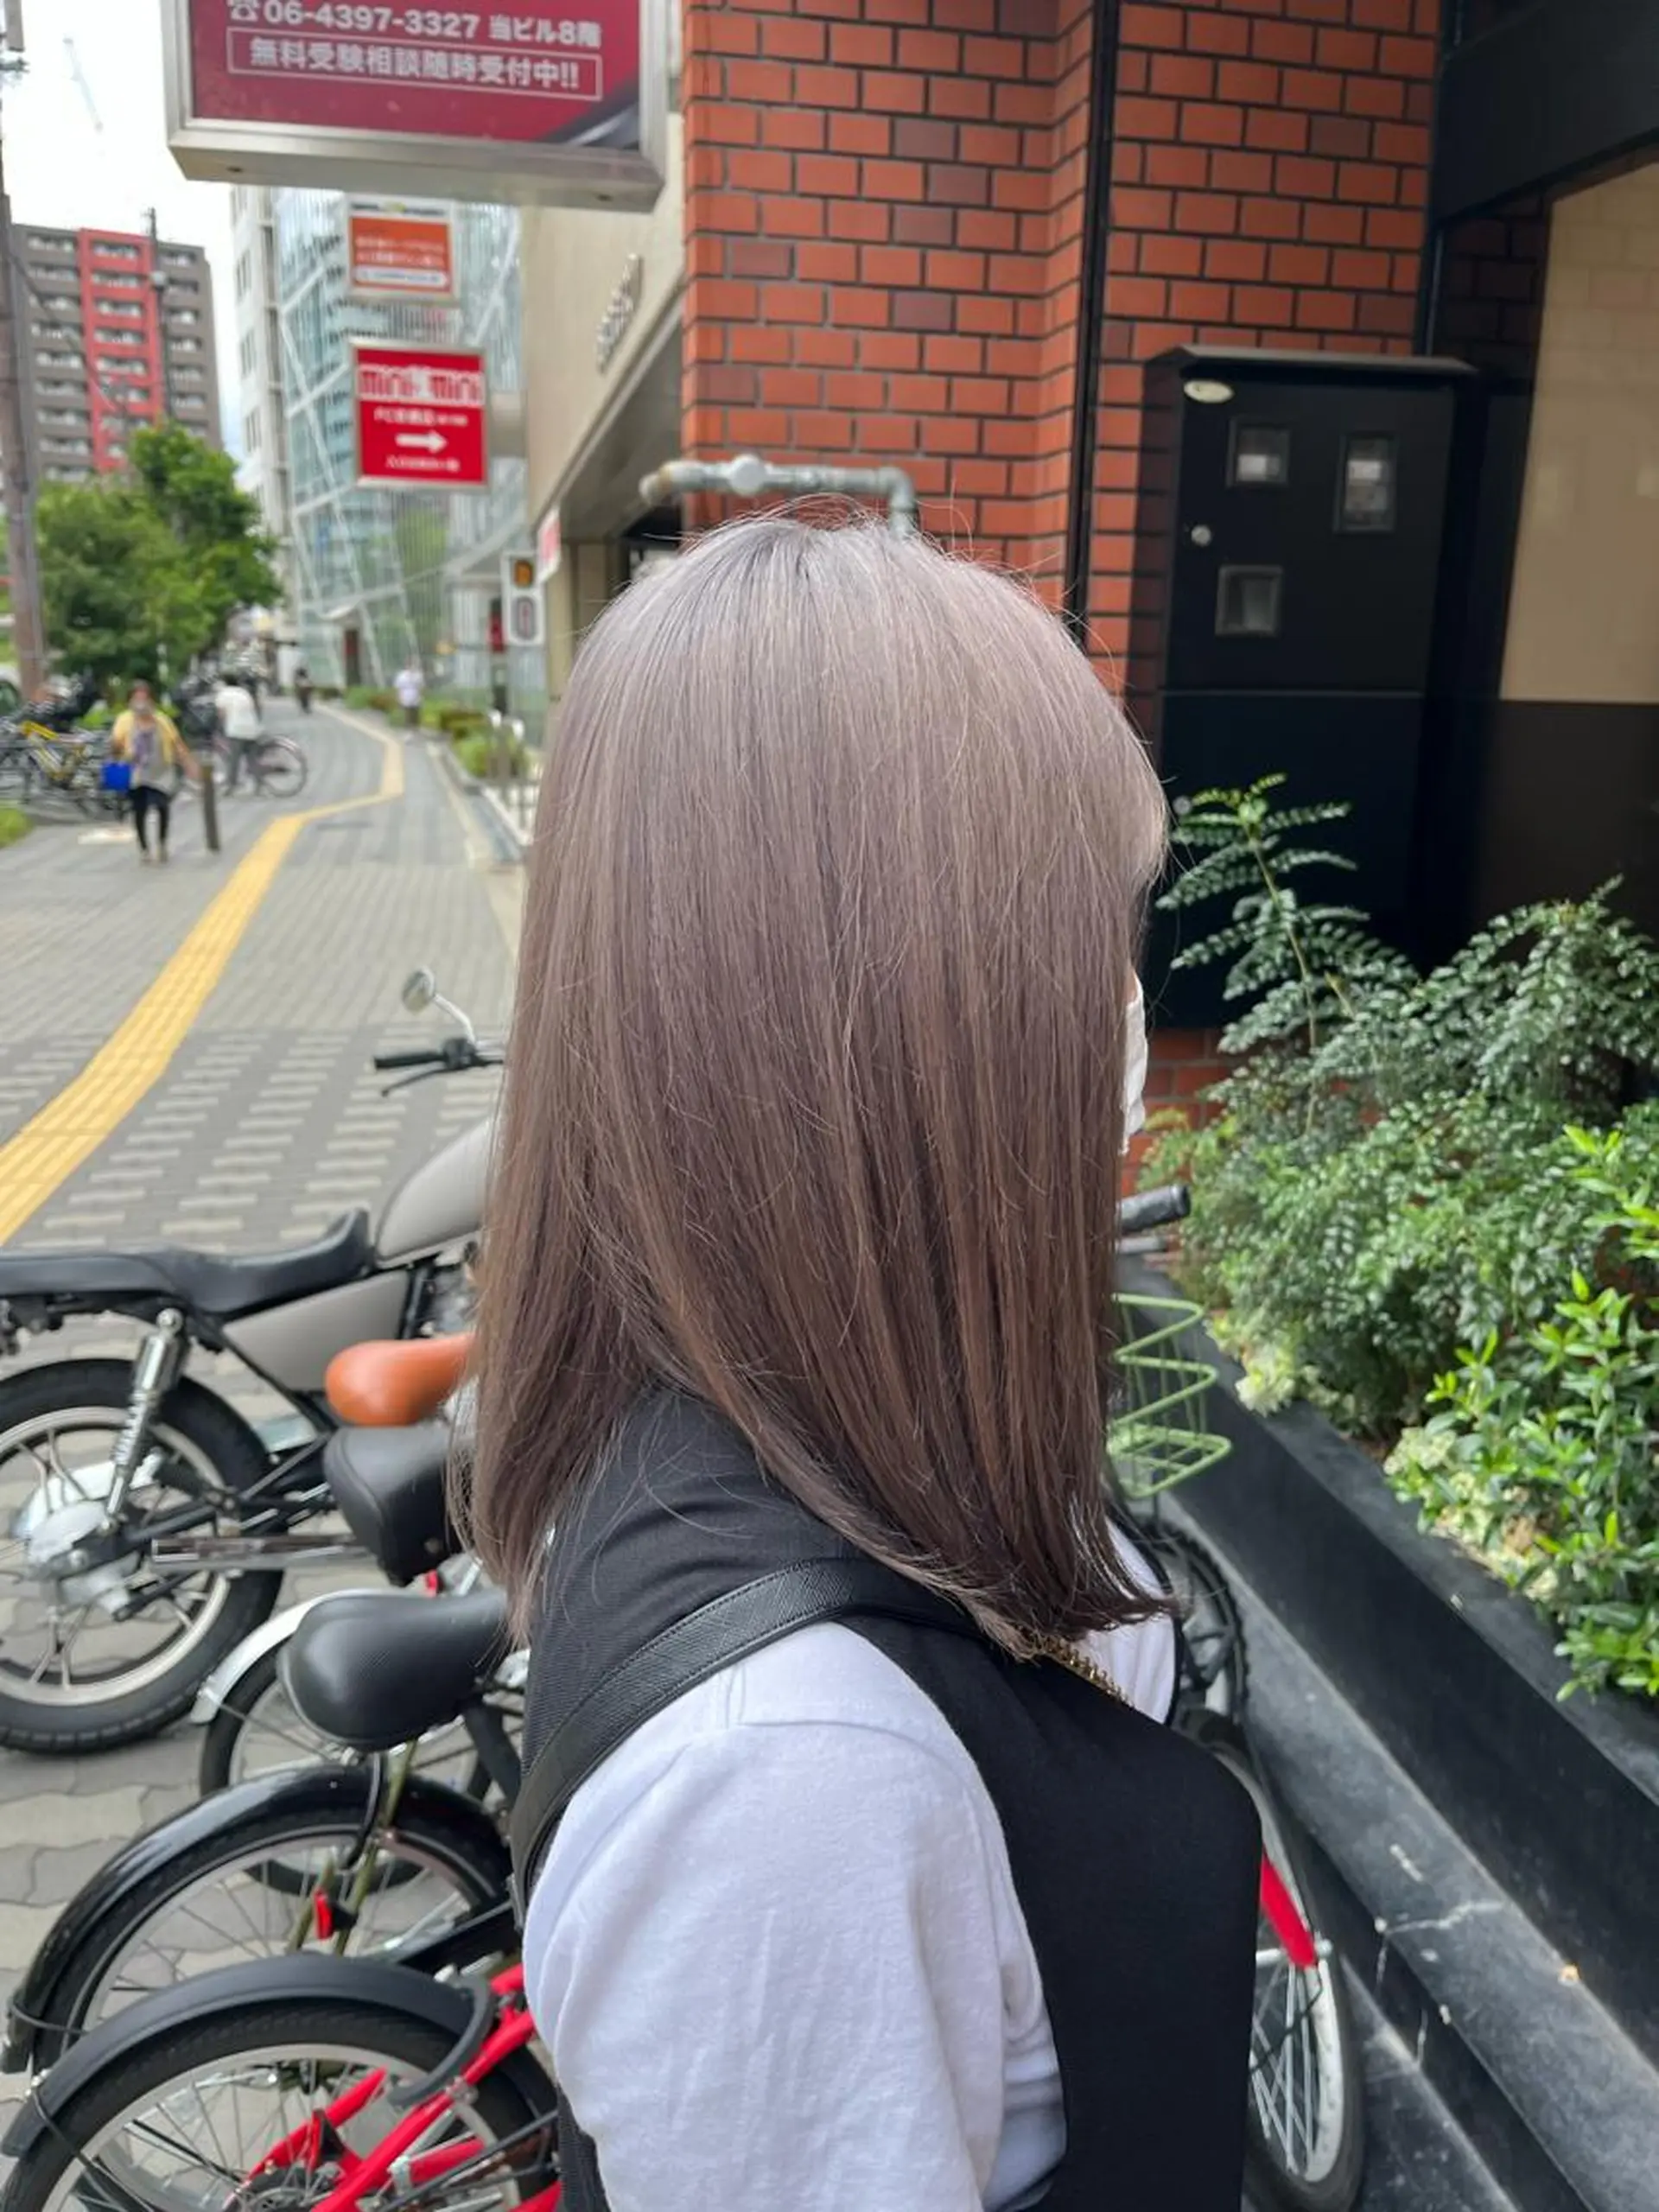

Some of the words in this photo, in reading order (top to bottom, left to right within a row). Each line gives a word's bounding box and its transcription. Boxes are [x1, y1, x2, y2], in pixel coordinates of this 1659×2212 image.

[263, 0, 480, 38] 06-4397-3327
[488, 14, 601, 48] 当ビル8階
